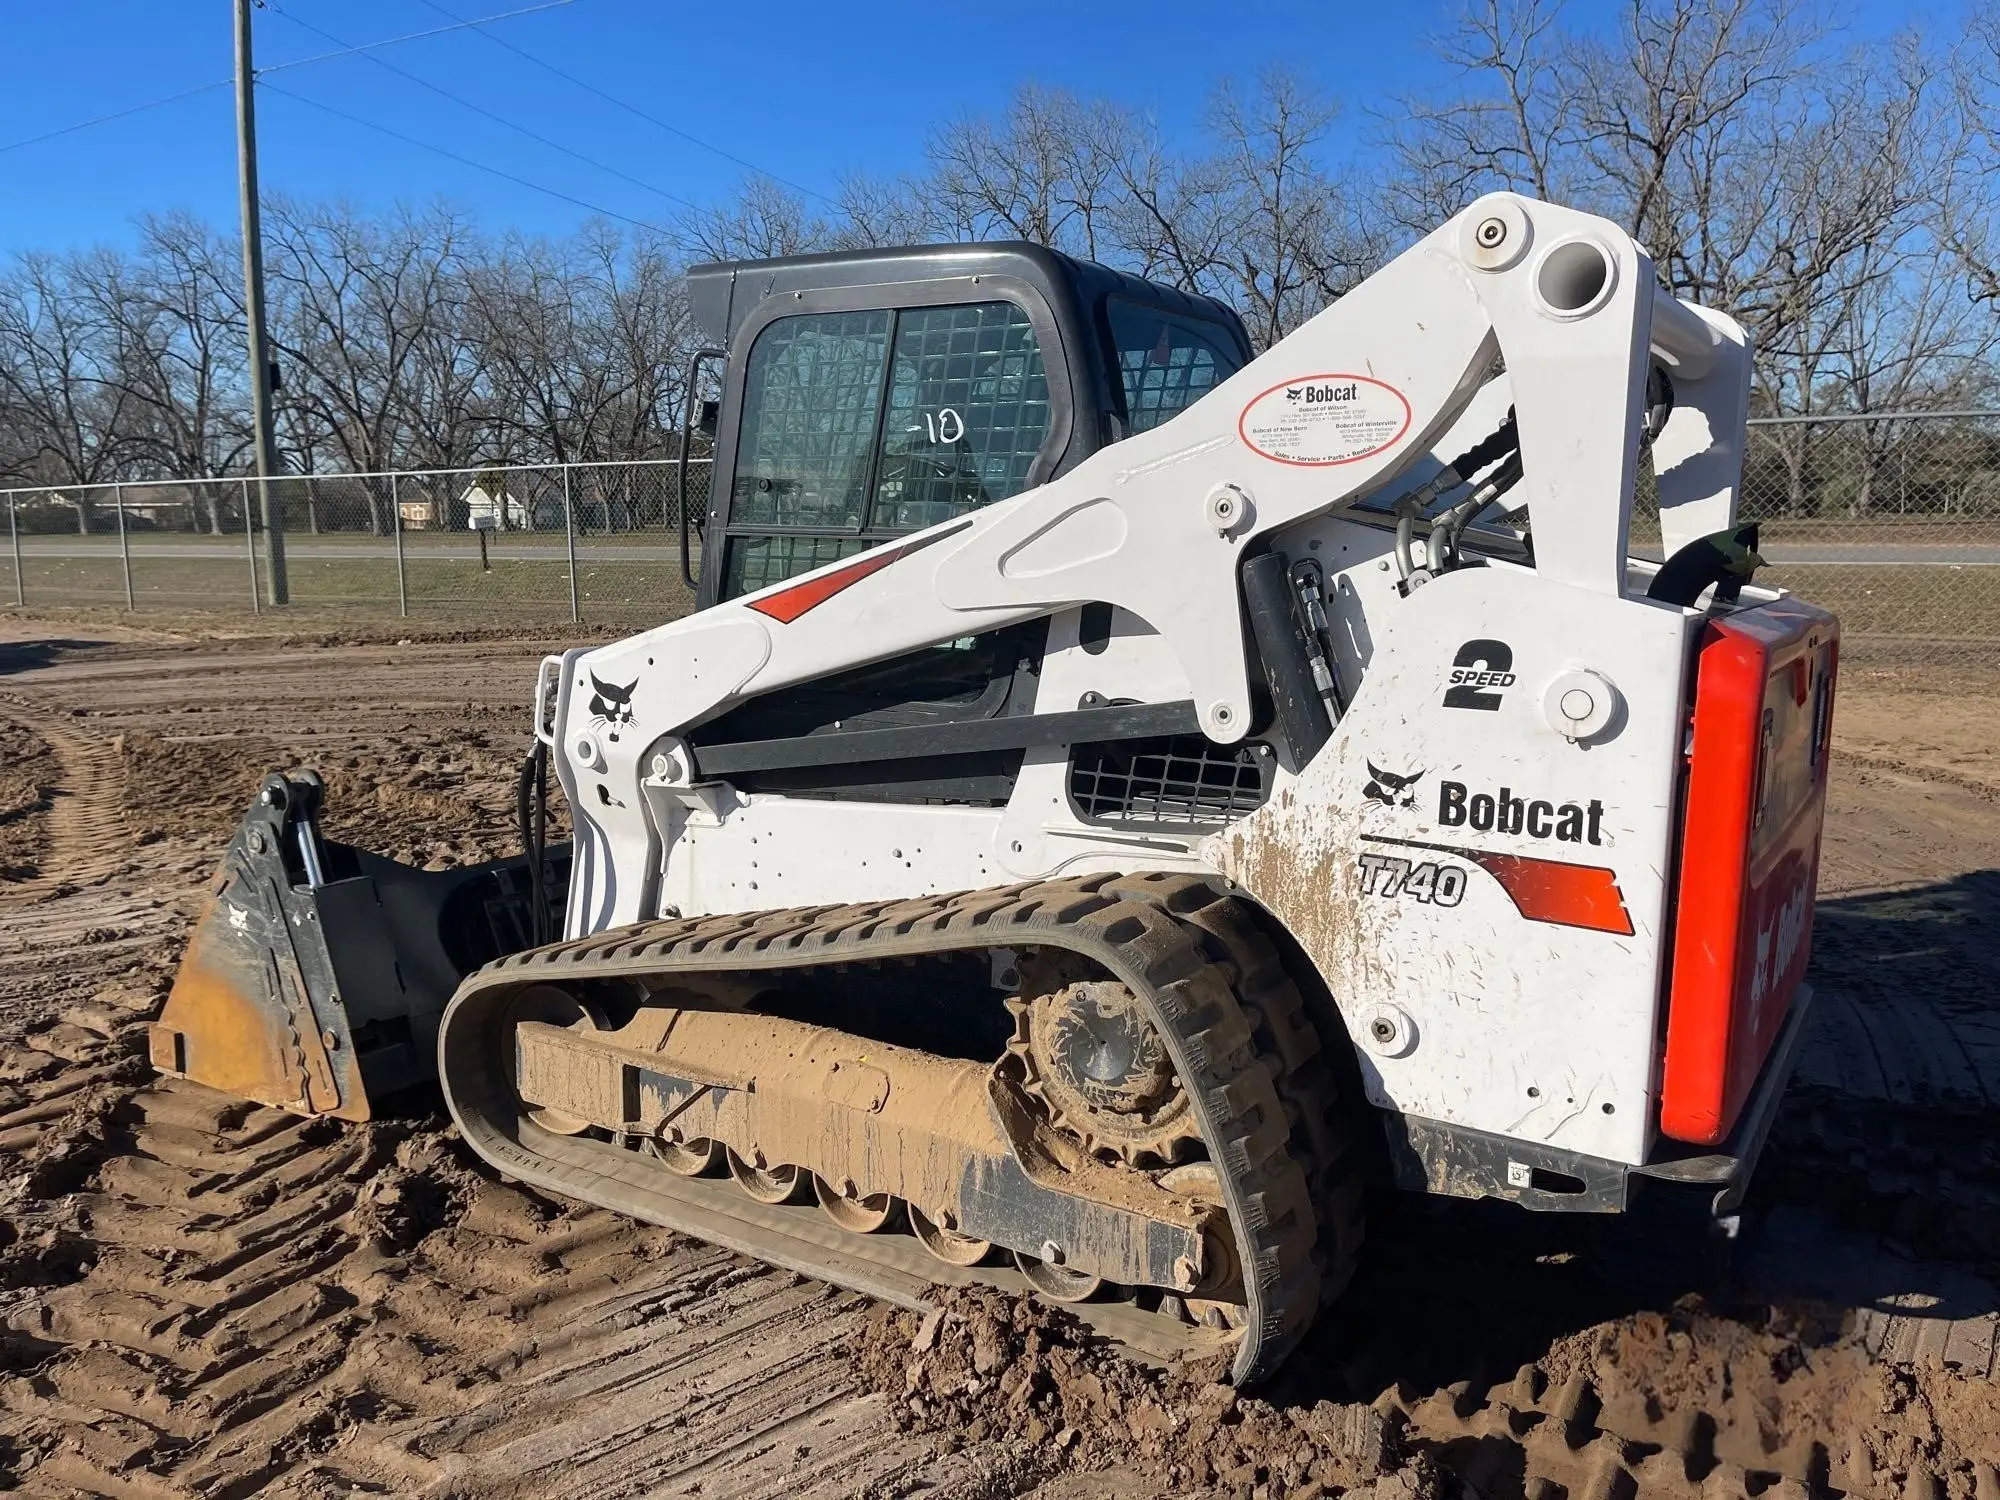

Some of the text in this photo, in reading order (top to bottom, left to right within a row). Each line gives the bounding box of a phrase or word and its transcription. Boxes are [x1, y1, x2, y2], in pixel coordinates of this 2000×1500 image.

[1306, 384, 1356, 403] Bobcat
[1273, 450, 1290, 459] Sales
[1352, 444, 1376, 456] Rentals
[1442, 639, 1513, 711] 2
[1449, 670, 1516, 687] SPEED
[1438, 780, 1604, 846] Bobcat
[1358, 853, 1467, 907] T740
